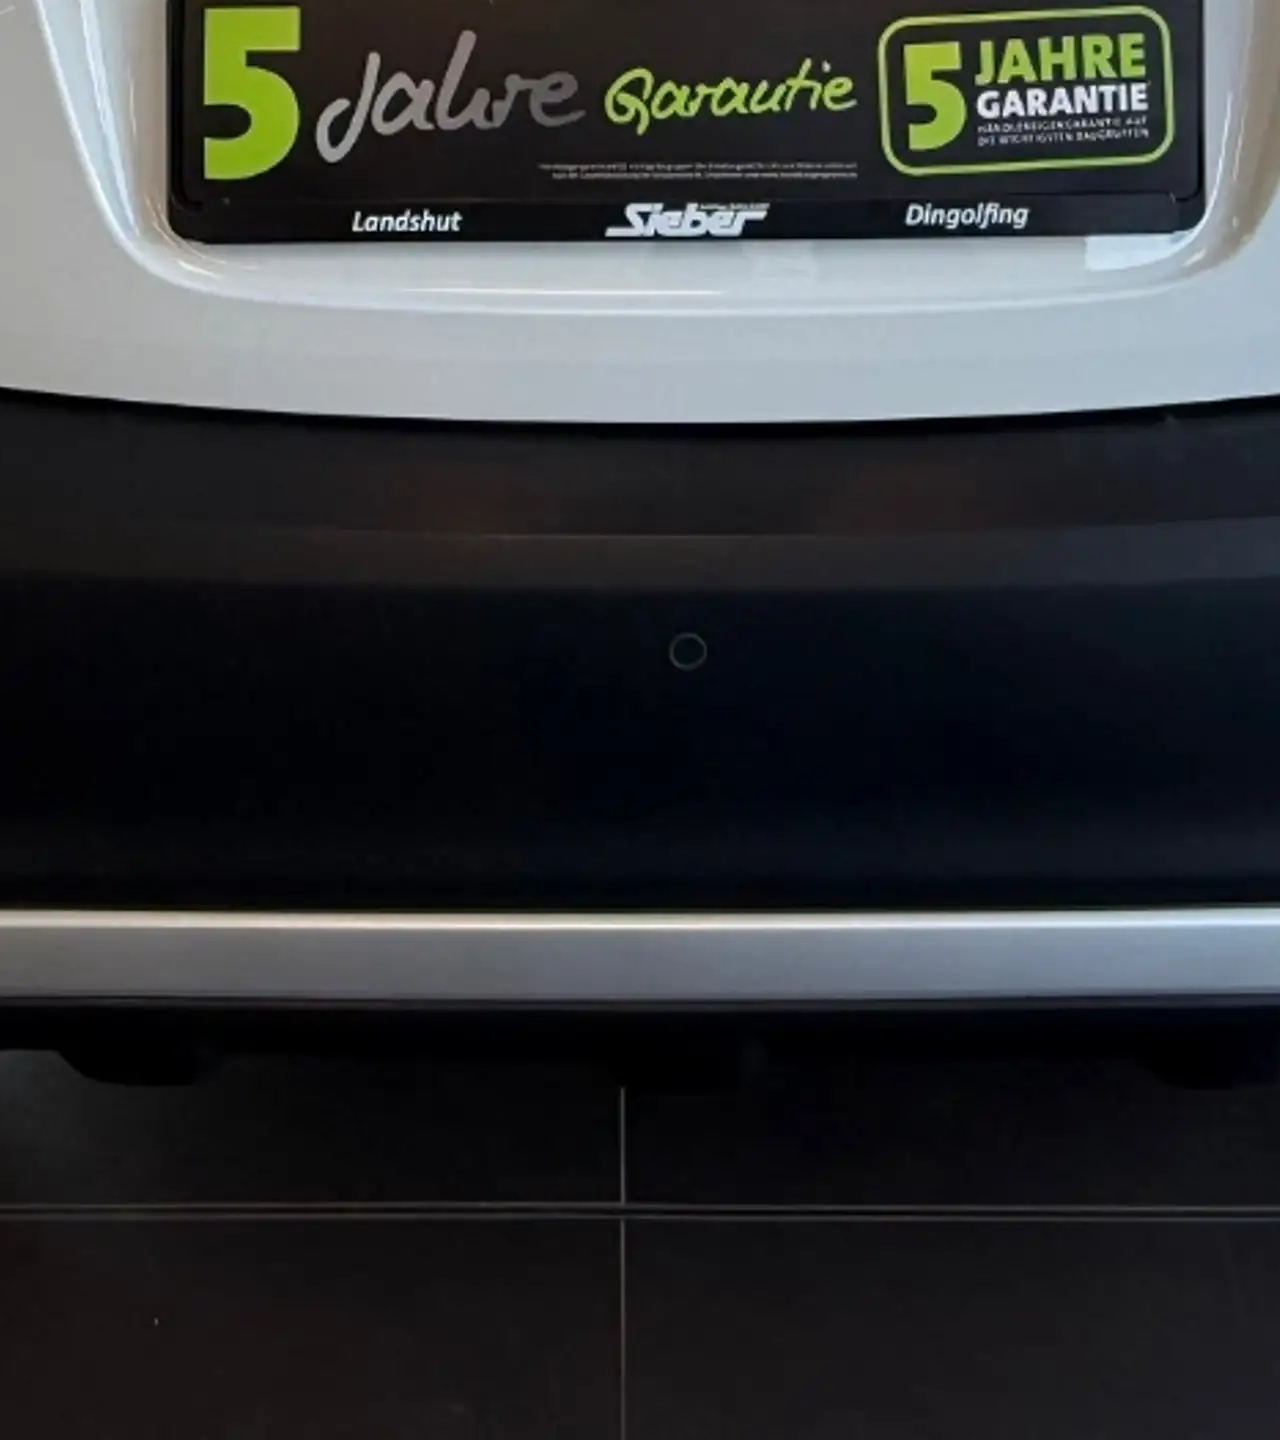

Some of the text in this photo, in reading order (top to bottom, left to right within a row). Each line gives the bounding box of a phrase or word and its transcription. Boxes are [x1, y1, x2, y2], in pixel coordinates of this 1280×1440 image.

[203, 5, 858, 180] 5 Jahre Garantie
[903, 32, 1147, 151] 5 JAHRE
[976, 82, 1150, 120] GARANTIE
[352, 209, 464, 234] Landshut
[604, 202, 769, 238] Sieber
[905, 201, 1031, 230] Dingolfing
